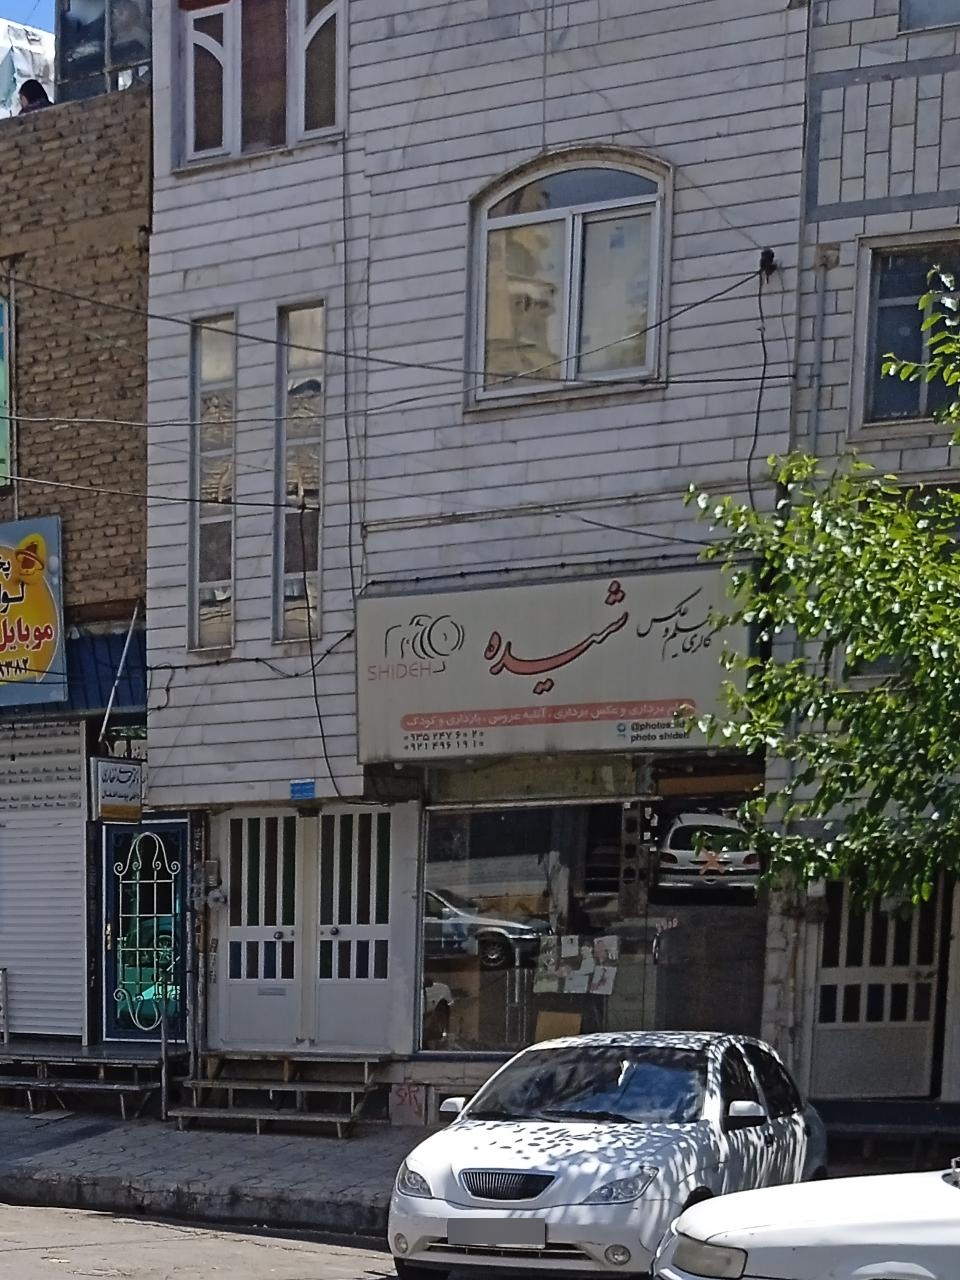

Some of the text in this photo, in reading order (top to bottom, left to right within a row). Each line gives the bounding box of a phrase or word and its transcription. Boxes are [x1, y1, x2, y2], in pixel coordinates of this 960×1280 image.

[483, 579, 629, 695] شیده
[367, 661, 433, 682] SHIDEH
[630, 731, 658, 743] photo
